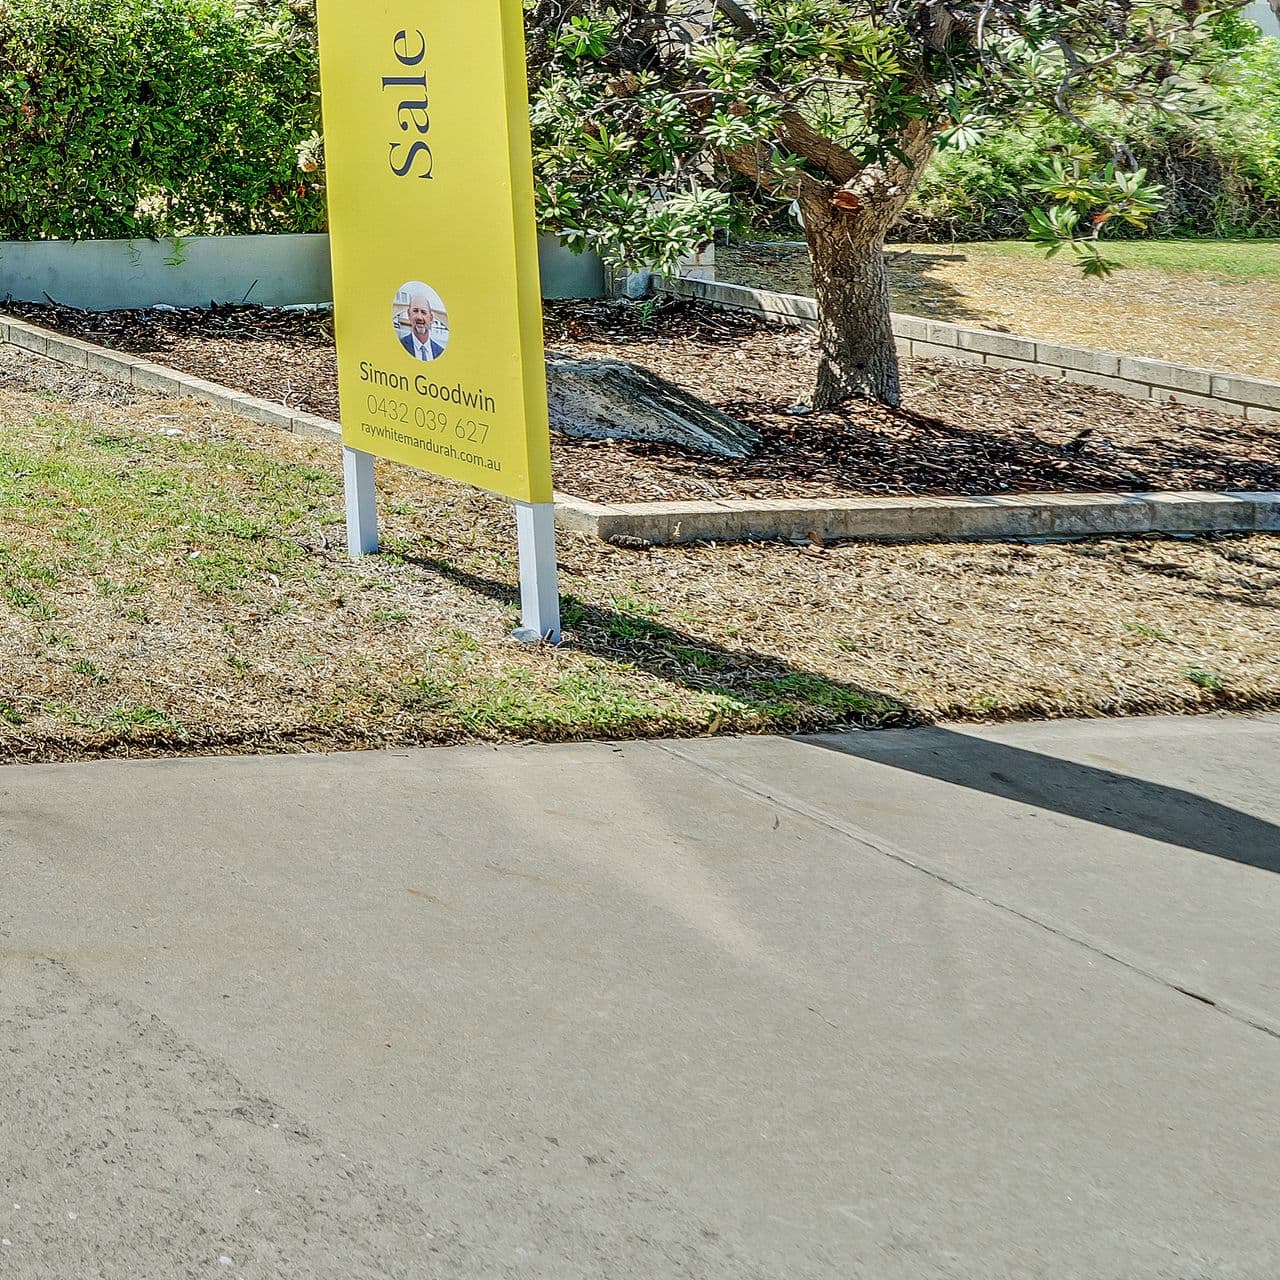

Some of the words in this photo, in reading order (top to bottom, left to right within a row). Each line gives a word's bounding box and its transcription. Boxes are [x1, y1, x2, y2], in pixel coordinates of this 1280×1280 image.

[381, 29, 433, 179] Sale
[360, 361, 409, 391] Simon
[414, 375, 496, 413] Goodwin
[367, 394, 409, 424] 0432
[414, 407, 448, 433] 039
[455, 418, 489, 444] 627
[361, 422, 502, 472] raywhitemandurah.com.au
